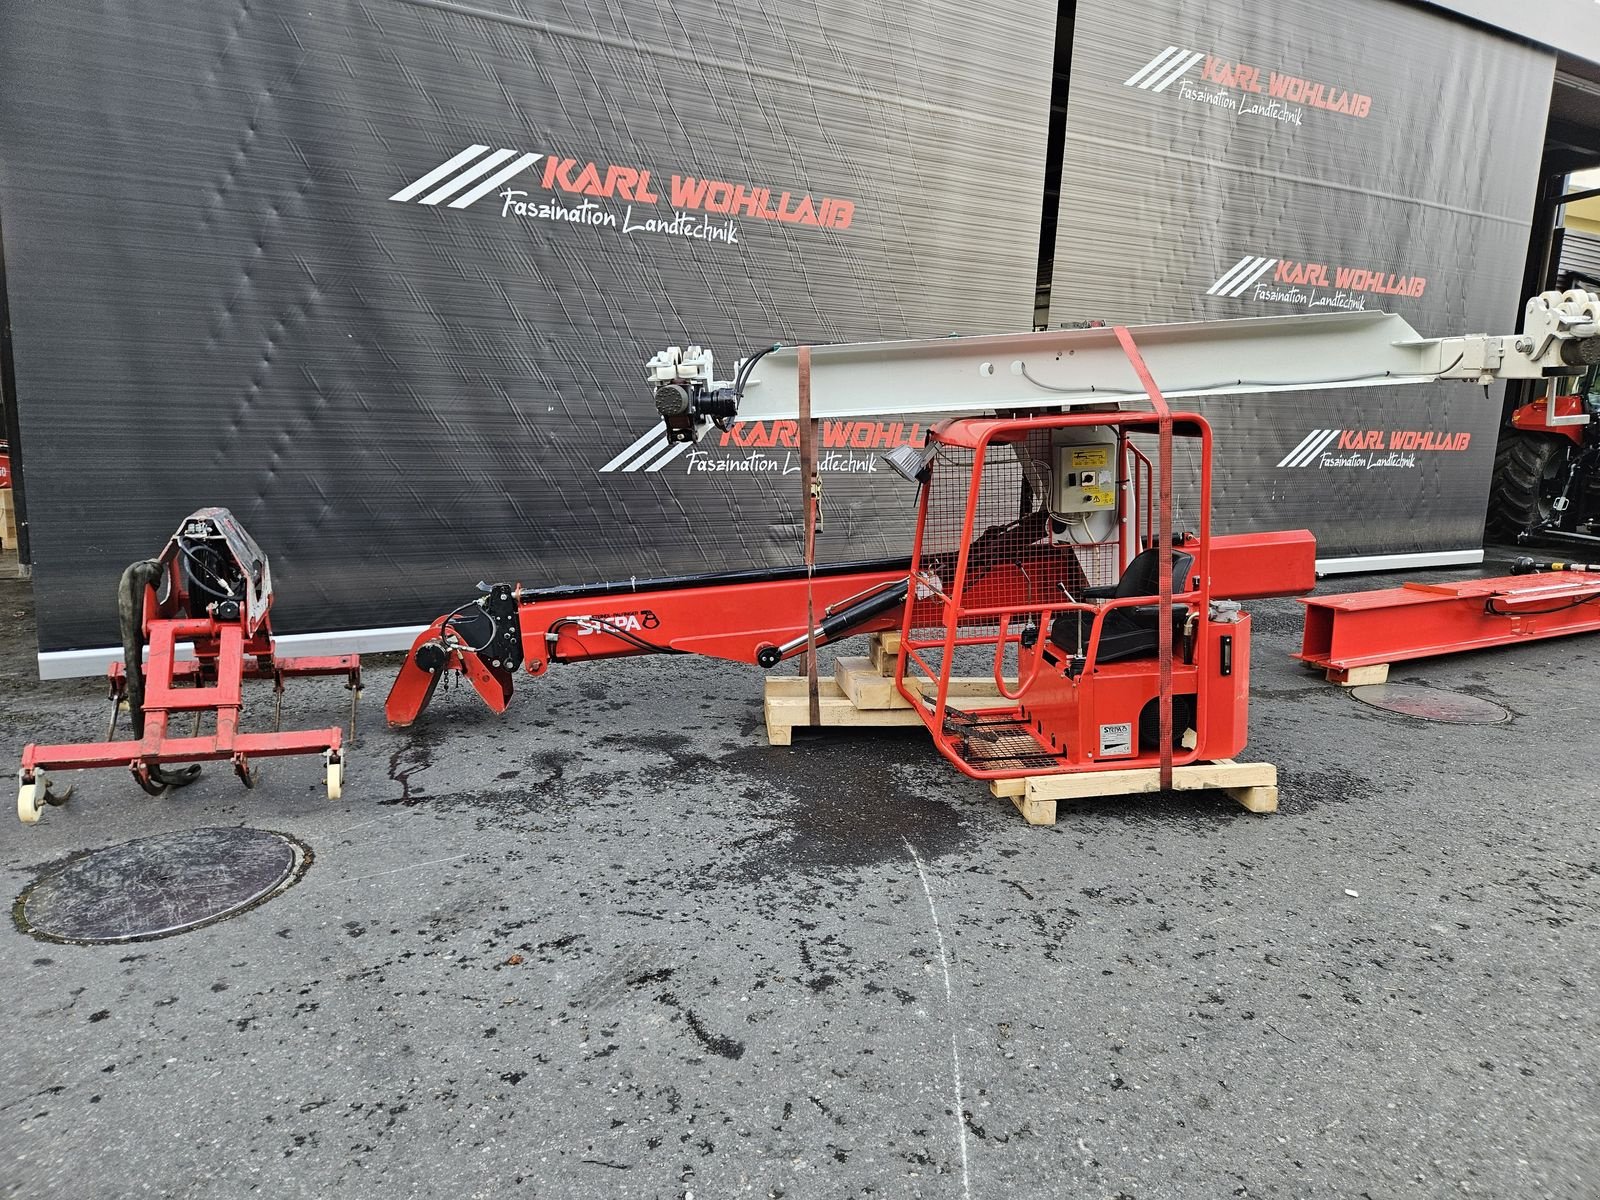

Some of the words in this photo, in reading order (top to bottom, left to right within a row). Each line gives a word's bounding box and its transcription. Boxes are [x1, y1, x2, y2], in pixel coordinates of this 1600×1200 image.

[1178, 78, 1236, 110] Faszination
[1238, 94, 1303, 126] Landtechnik
[1201, 54, 1261, 94] KARL
[1268, 71, 1372, 118] WOHLLAIB
[541, 155, 658, 203] KARL
[671, 174, 856, 230] WOHLLAIB
[499, 187, 616, 227] Faszination
[622, 205, 739, 244] Landtechnik
[1274, 258, 1329, 287] KARL
[1335, 267, 1427, 298] WOHLLAIB
[1253, 282, 1307, 304] Faszination
[1308, 286, 1366, 312] Landtechnik
[719, 419, 801, 448] KAR
[822, 420, 926, 449] WOHLL
[1337, 429, 1385, 450] KARL
[1389, 431, 1472, 451] WOHLLAIB
[685, 449, 778, 475] Faszination
[1319, 451, 1366, 469] Faszination
[1366, 452, 1415, 470] Landtechnik
